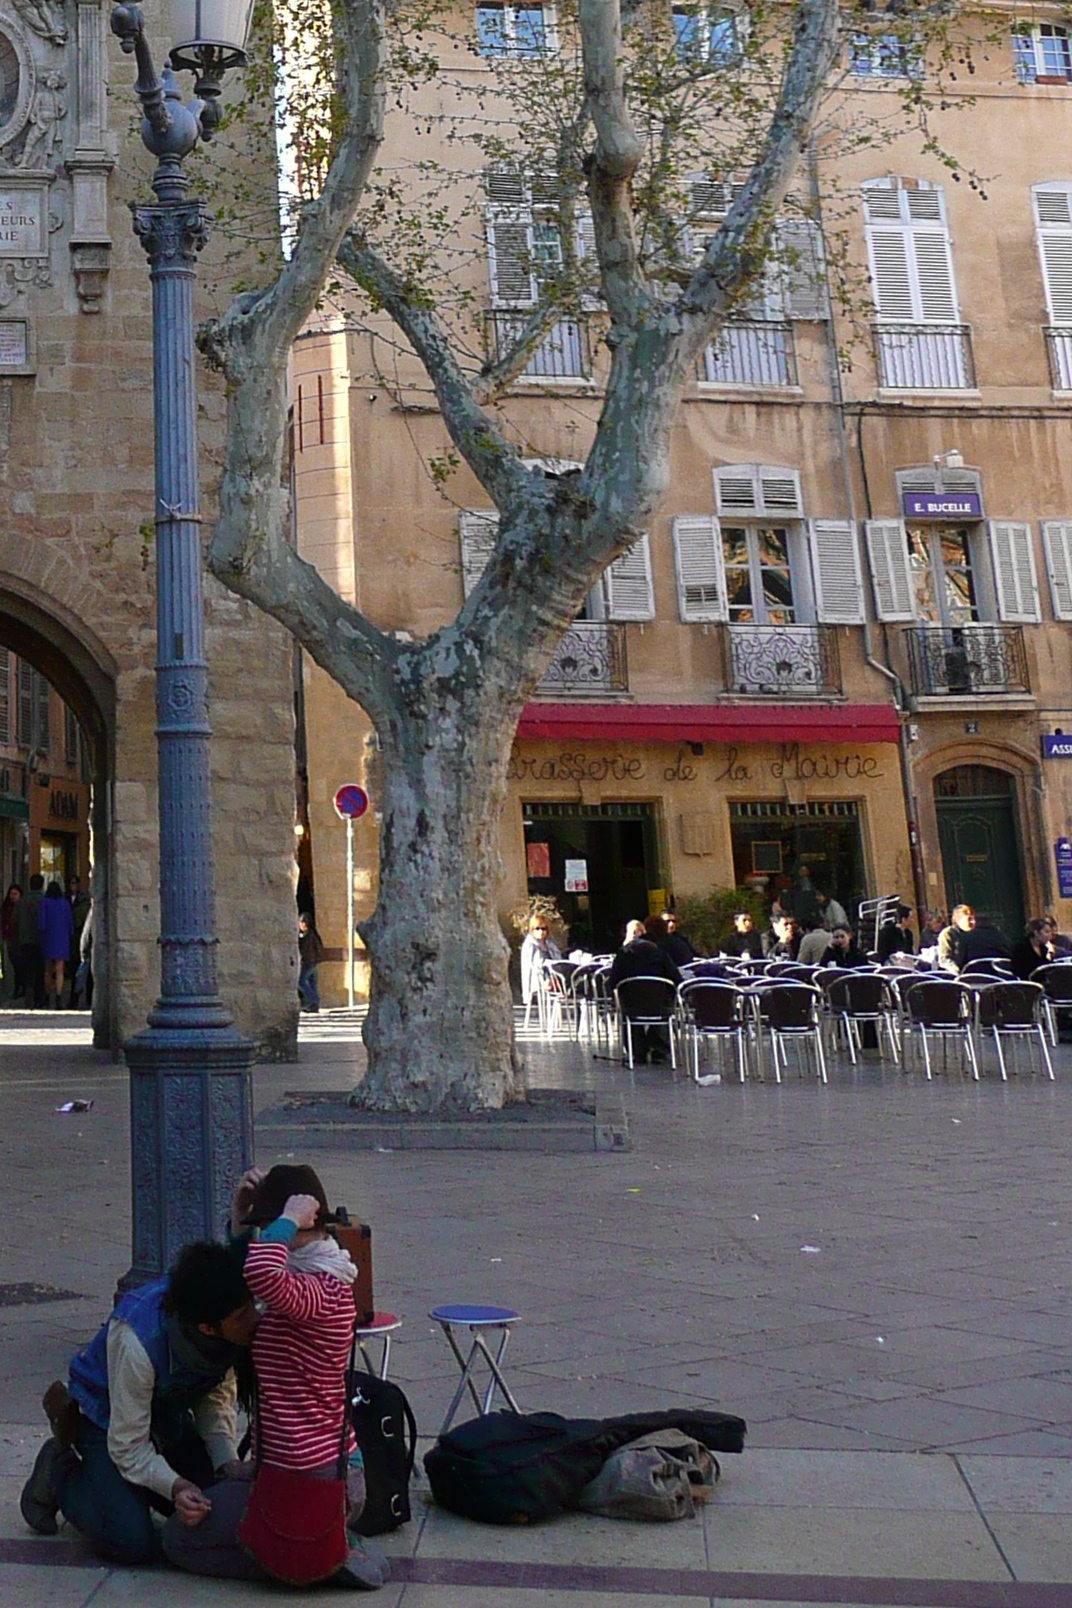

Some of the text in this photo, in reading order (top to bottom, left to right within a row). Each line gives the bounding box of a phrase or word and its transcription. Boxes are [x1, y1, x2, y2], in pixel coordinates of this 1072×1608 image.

[914, 503, 972, 513] E. BUCELLE
[663, 749, 698, 781] de
[714, 747, 753, 781] la
[770, 742, 885, 779] Mairie
